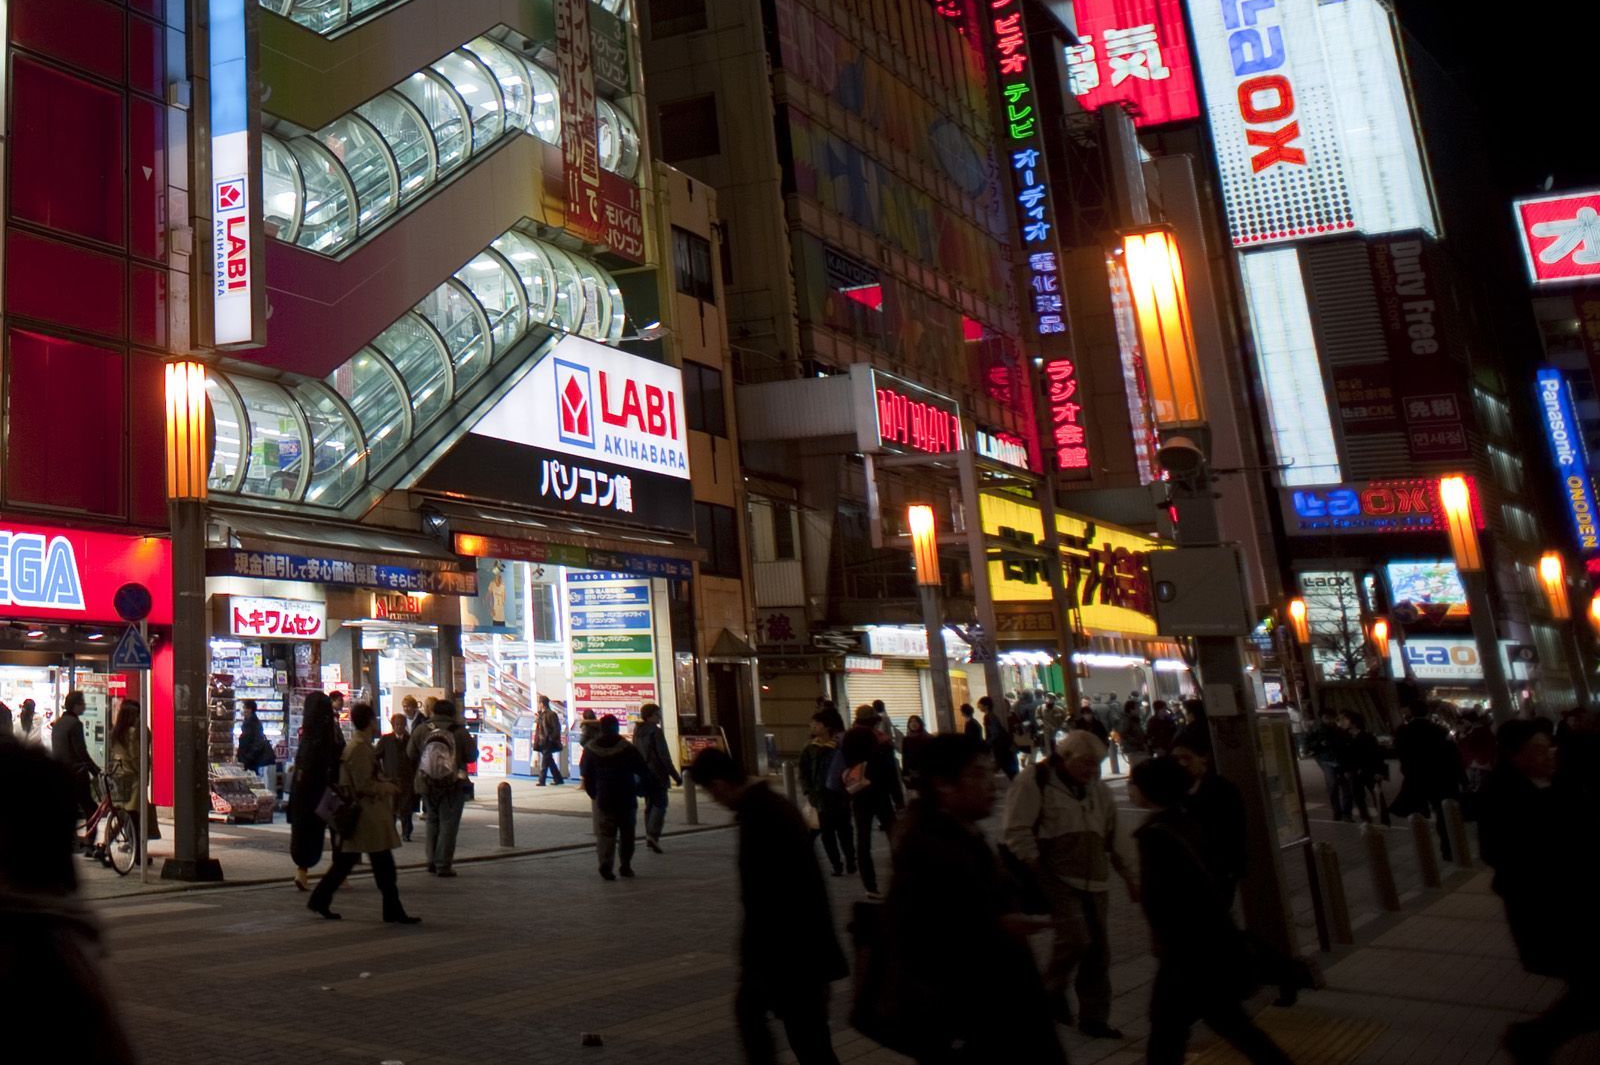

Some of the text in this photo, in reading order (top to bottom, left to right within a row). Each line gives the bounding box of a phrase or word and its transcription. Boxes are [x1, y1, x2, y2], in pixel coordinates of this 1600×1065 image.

[994, 14, 1026, 74] ビデオ
[1005, 84, 1037, 140] テレビ
[1013, 148, 1051, 243] オーディオ
[217, 219, 226, 297] AKIHABARA
[225, 215, 248, 293] LABI
[1029, 251, 1066, 335] 電化製品
[1401, 298, 1440, 356] Free
[599, 370, 679, 441] LABI
[1046, 358, 1089, 469] ラジオ会館
[1539, 379, 1574, 467] Panasonic
[540, 458, 633, 513] パソコン館
[603, 433, 687, 471] AKIHABARA
[1567, 476, 1599, 550] ONODEN
[233, 607, 321, 636] トキワムセン
[997, 612, 1055, 631] ジオ会館
